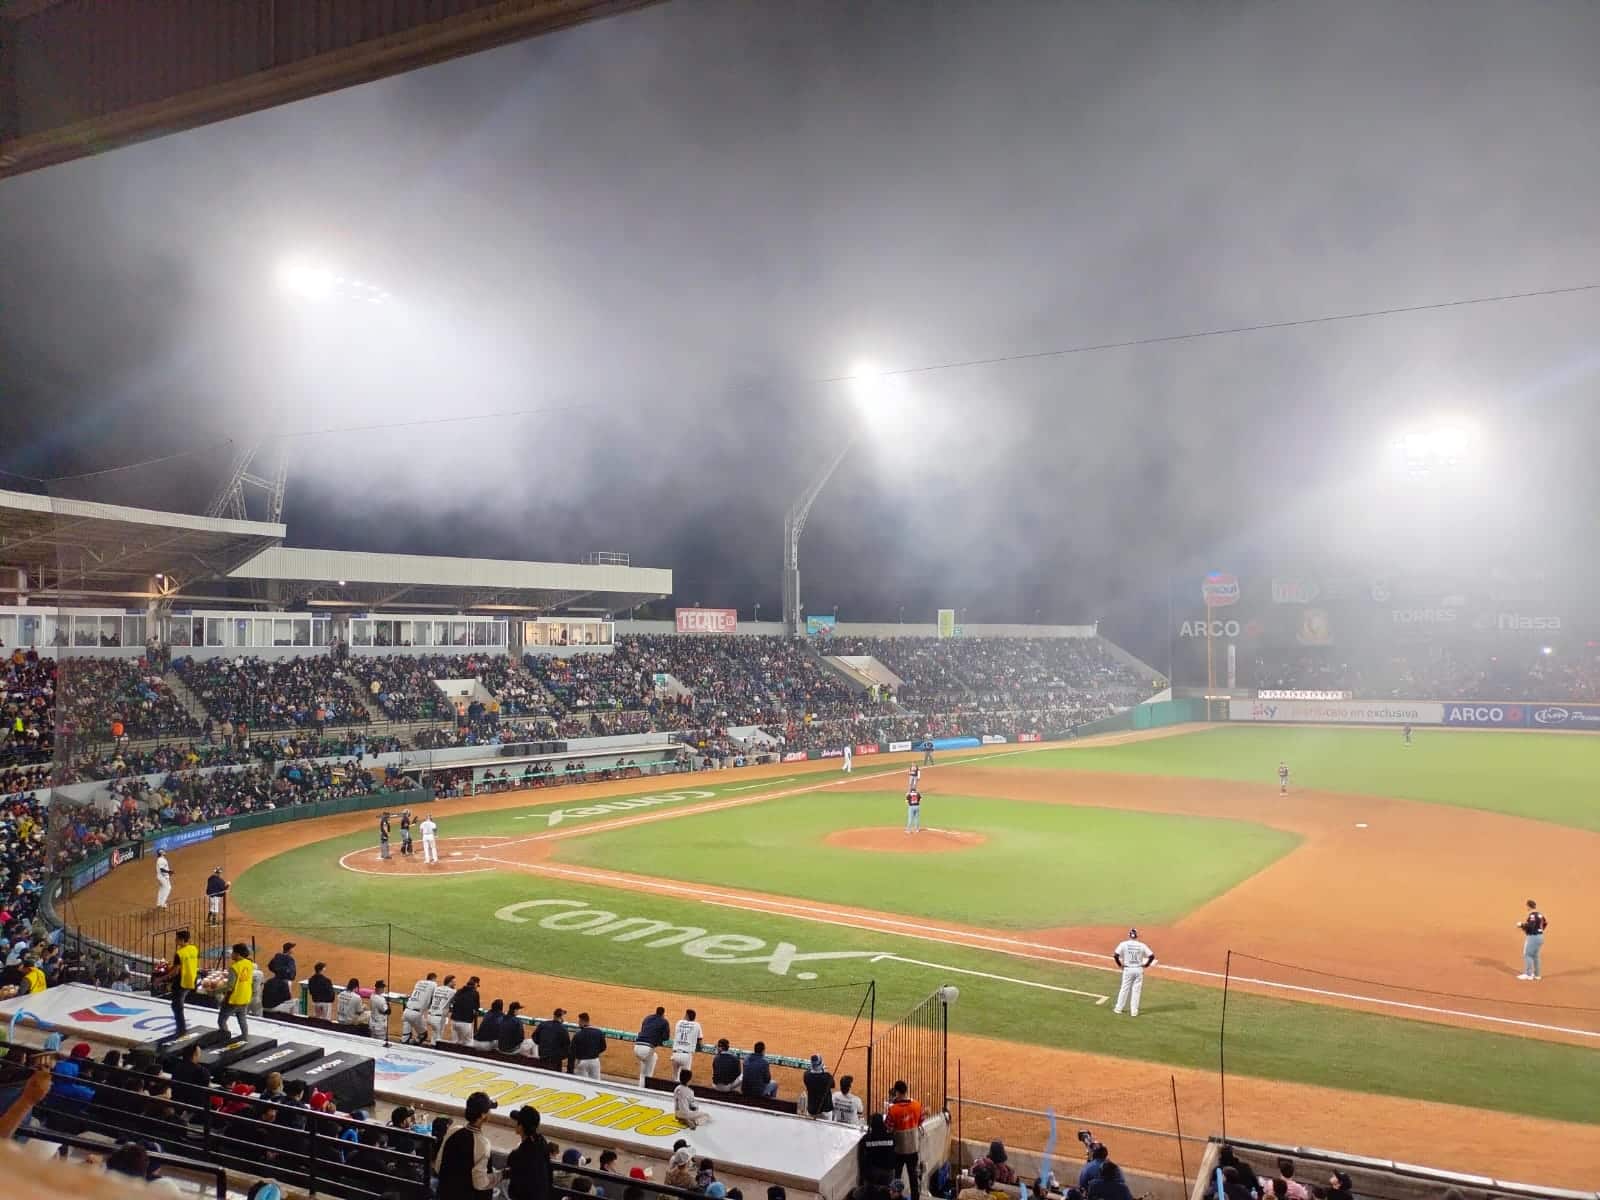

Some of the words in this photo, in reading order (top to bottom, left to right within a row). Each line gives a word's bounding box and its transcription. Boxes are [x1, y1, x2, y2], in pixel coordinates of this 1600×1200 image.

[679, 611, 728, 630] TECATE
[1179, 620, 1240, 638] ARCO
[1367, 706, 1419, 719] exclusiva
[1450, 706, 1504, 721] ARCO
